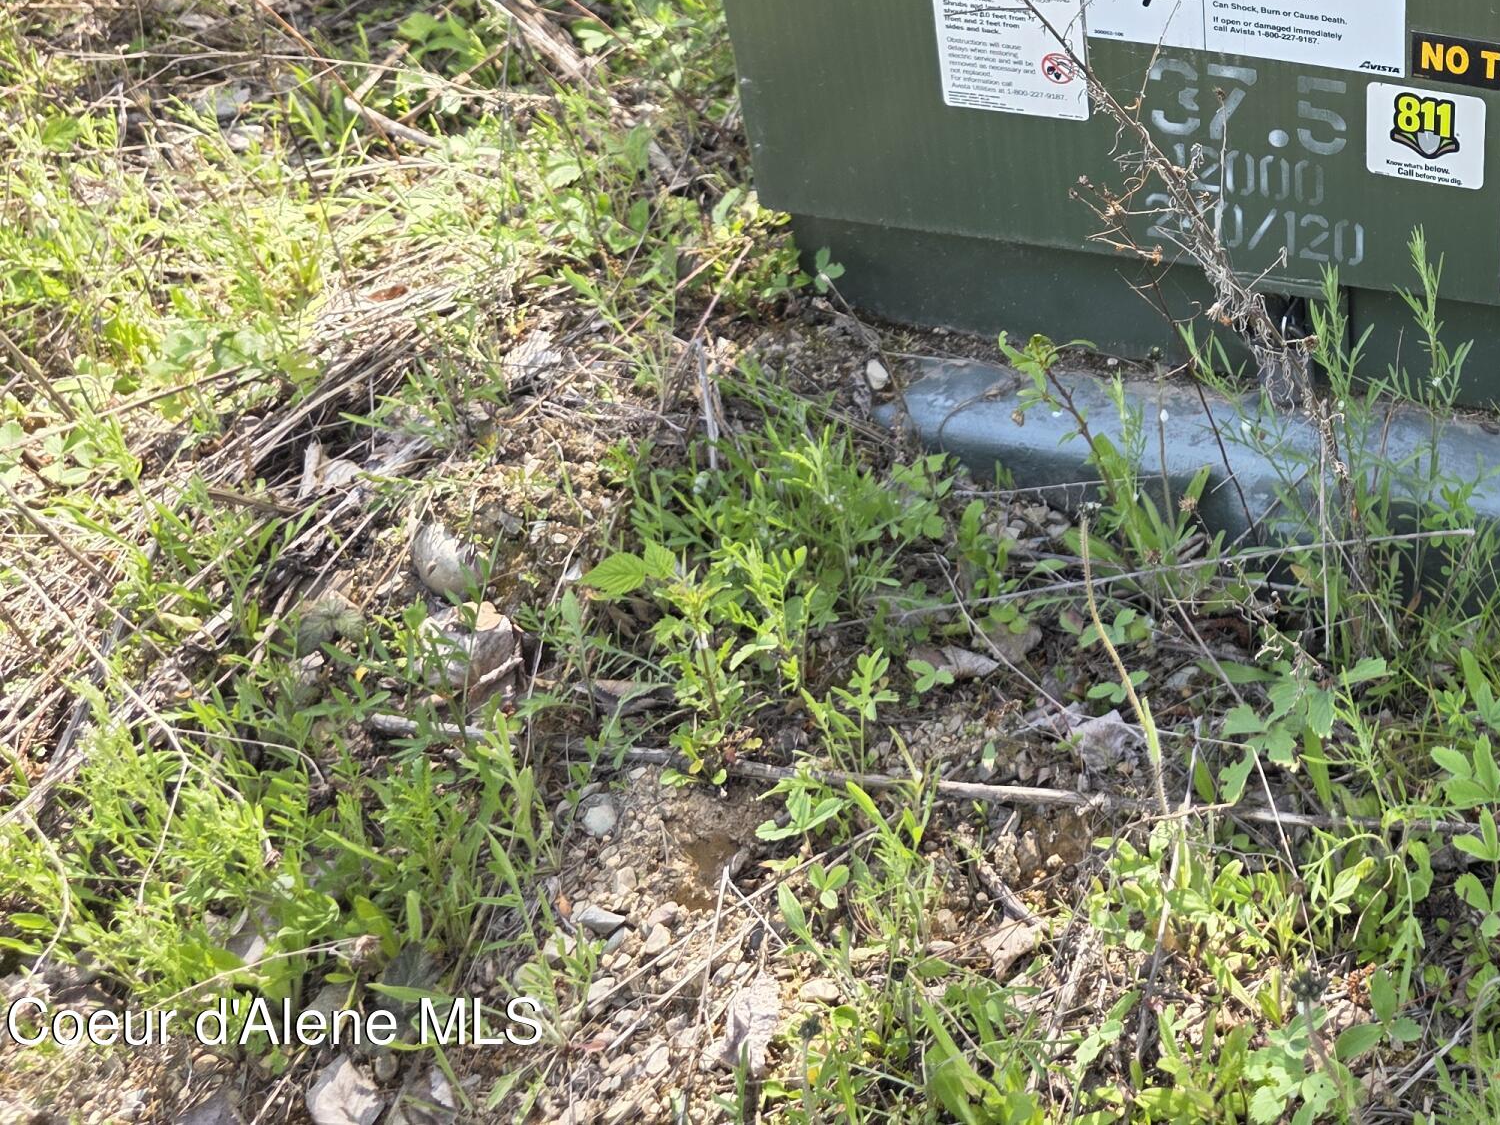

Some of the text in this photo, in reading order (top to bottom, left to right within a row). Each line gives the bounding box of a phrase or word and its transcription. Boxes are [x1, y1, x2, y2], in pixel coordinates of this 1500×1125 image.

[943, 0, 968, 8] Shrubs
[992, 12, 1007, 20] feet
[1009, 14, 1026, 22] from
[1212, 0, 1229, 9] Can
[1231, 2, 1259, 14] Shock,
[1261, 6, 1280, 16] Burn
[1293, 11, 1319, 21] Cause
[1321, 14, 1348, 25] Death.
[964, 16, 977, 24] and
[1002, 21, 1020, 29] from
[1221, 18, 1241, 27] open
[1254, 21, 1291, 33] damaged
[1293, 26, 1343, 41] immediately
[981, 27, 1002, 35] back.
[1213, 24, 1228, 32] call
[1230, 27, 1255, 36] Avista
[946, 36, 988, 47] Obstructions
[1001, 43, 1022, 51] cause
[948, 44, 968, 53] delays
[948, 52, 972, 60] electric
[974, 55, 996, 63] service
[1421, 41, 1470, 75] NO
[949, 60, 978, 68] removed
[988, 64, 1021, 74] necessary
[952, 82, 971, 90] Avista
[963, 76, 1000, 86] information
[1148, 58, 1347, 155] 37.5
[1397, 95, 1452, 138] 811
[1386, 159, 1450, 175] Know what's below.
[1397, 167, 1414, 177] Call
[1415, 172, 1436, 181] before
[1438, 176, 1450, 184] you
[1450, 177, 1463, 186] dig.
[1145, 192, 1364, 266] 20/120
